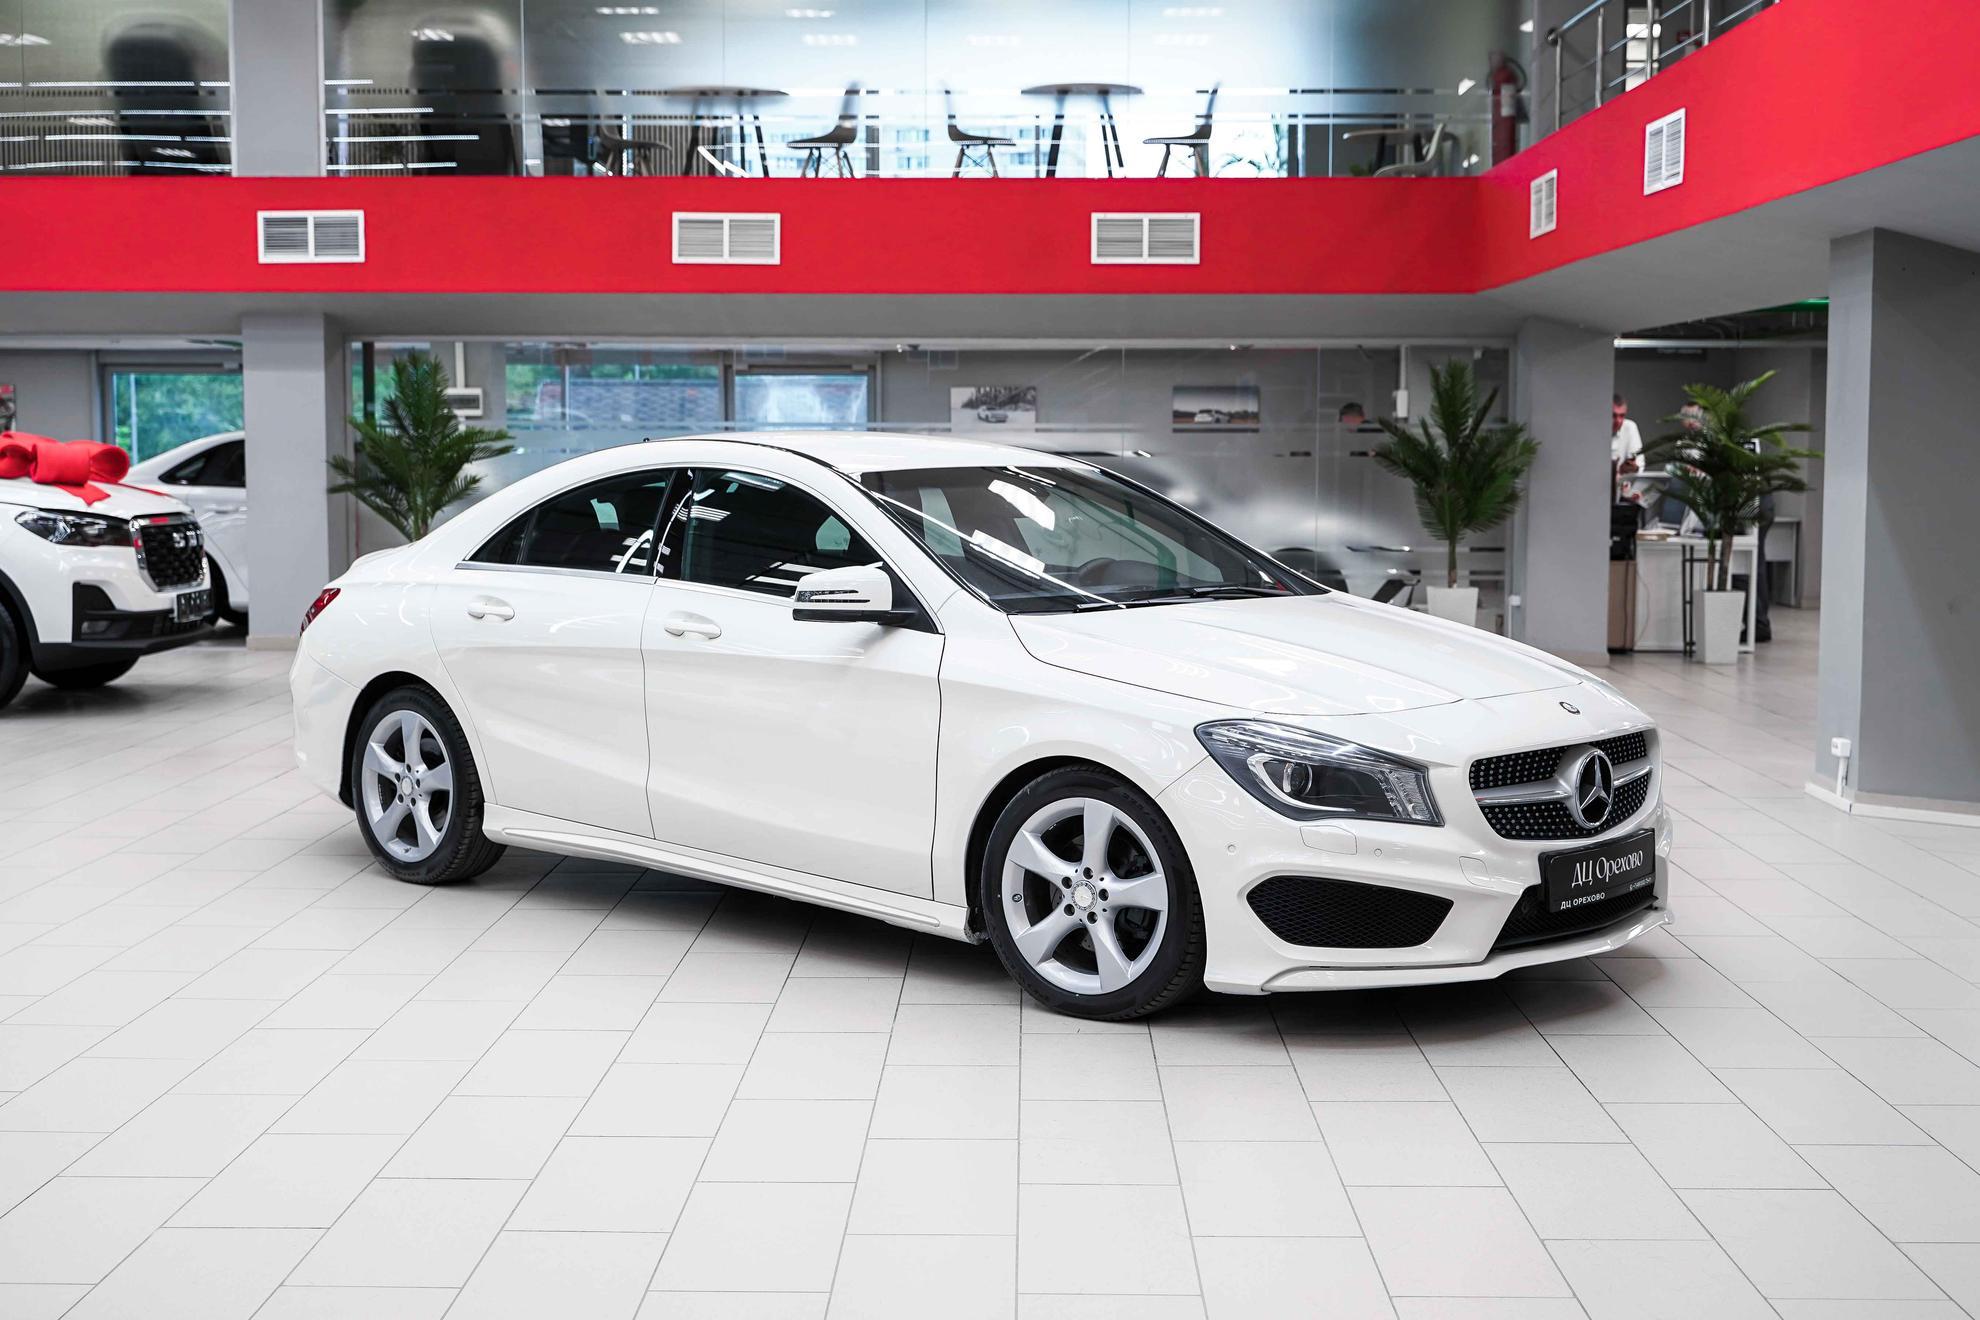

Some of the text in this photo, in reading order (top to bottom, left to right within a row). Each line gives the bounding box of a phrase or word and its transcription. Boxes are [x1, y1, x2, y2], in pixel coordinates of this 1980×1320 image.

[1571, 850, 1643, 888] ДЦ Орехово
[1560, 892, 1605, 910] ДЦ ОРЕХОВО
